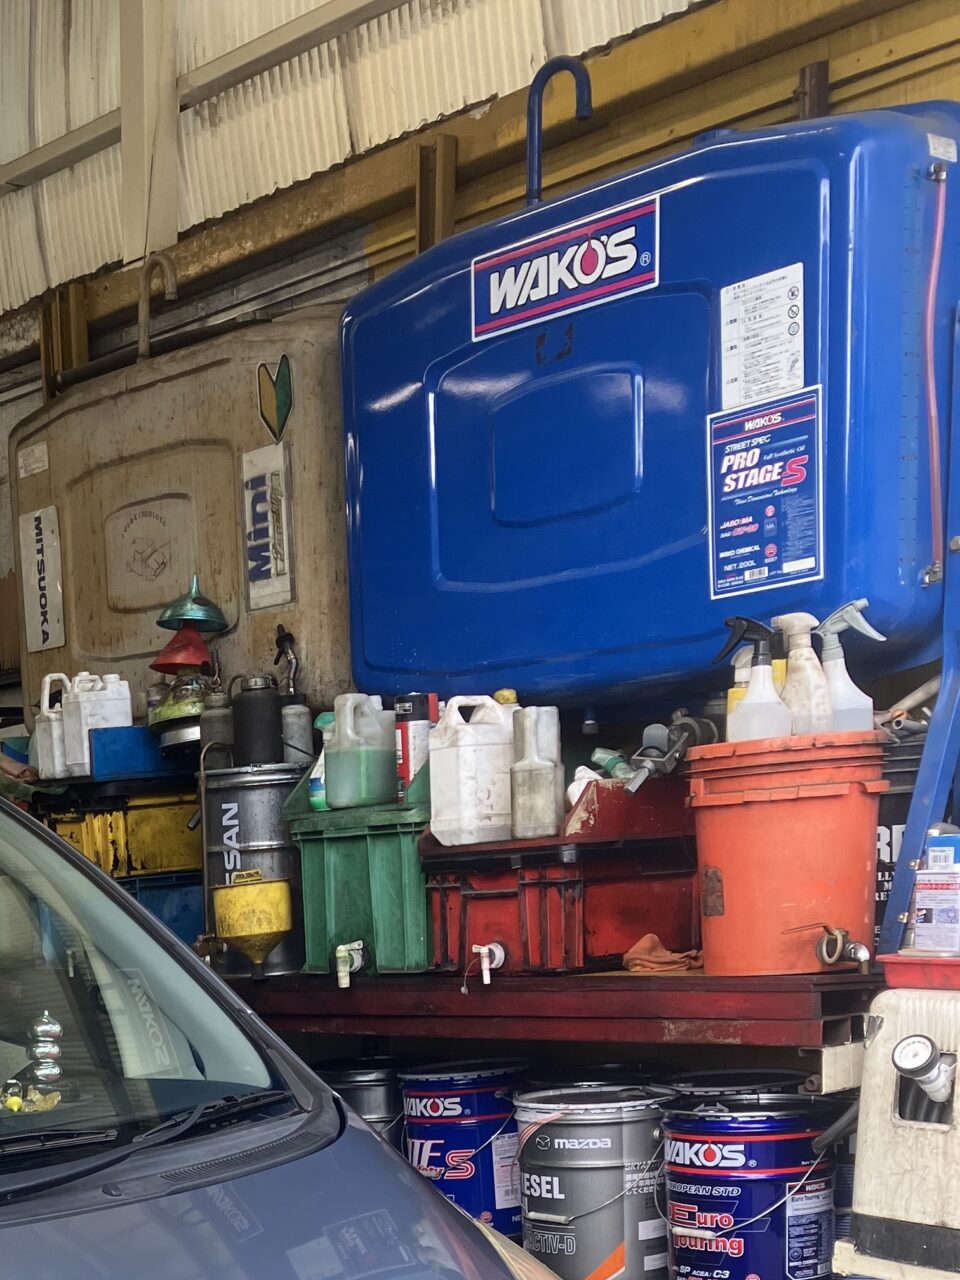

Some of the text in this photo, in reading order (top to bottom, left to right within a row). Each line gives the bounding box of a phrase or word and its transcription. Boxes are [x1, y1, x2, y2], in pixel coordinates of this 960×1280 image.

[489, 225, 638, 314] WAKO'S
[745, 412, 782, 431] WAKO'S
[725, 434, 772, 453] STREET SPEC
[721, 448, 761, 474] PRO
[723, 454, 809, 492] STAGE S
[245, 472, 272, 583] Mini
[34, 515, 50, 645] MITSUOKA
[712, 1186, 742, 1197] STD
[668, 1202, 735, 1229] Euro
[679, 1265, 691, 1274] SP
[712, 1270, 731, 1279] C3
